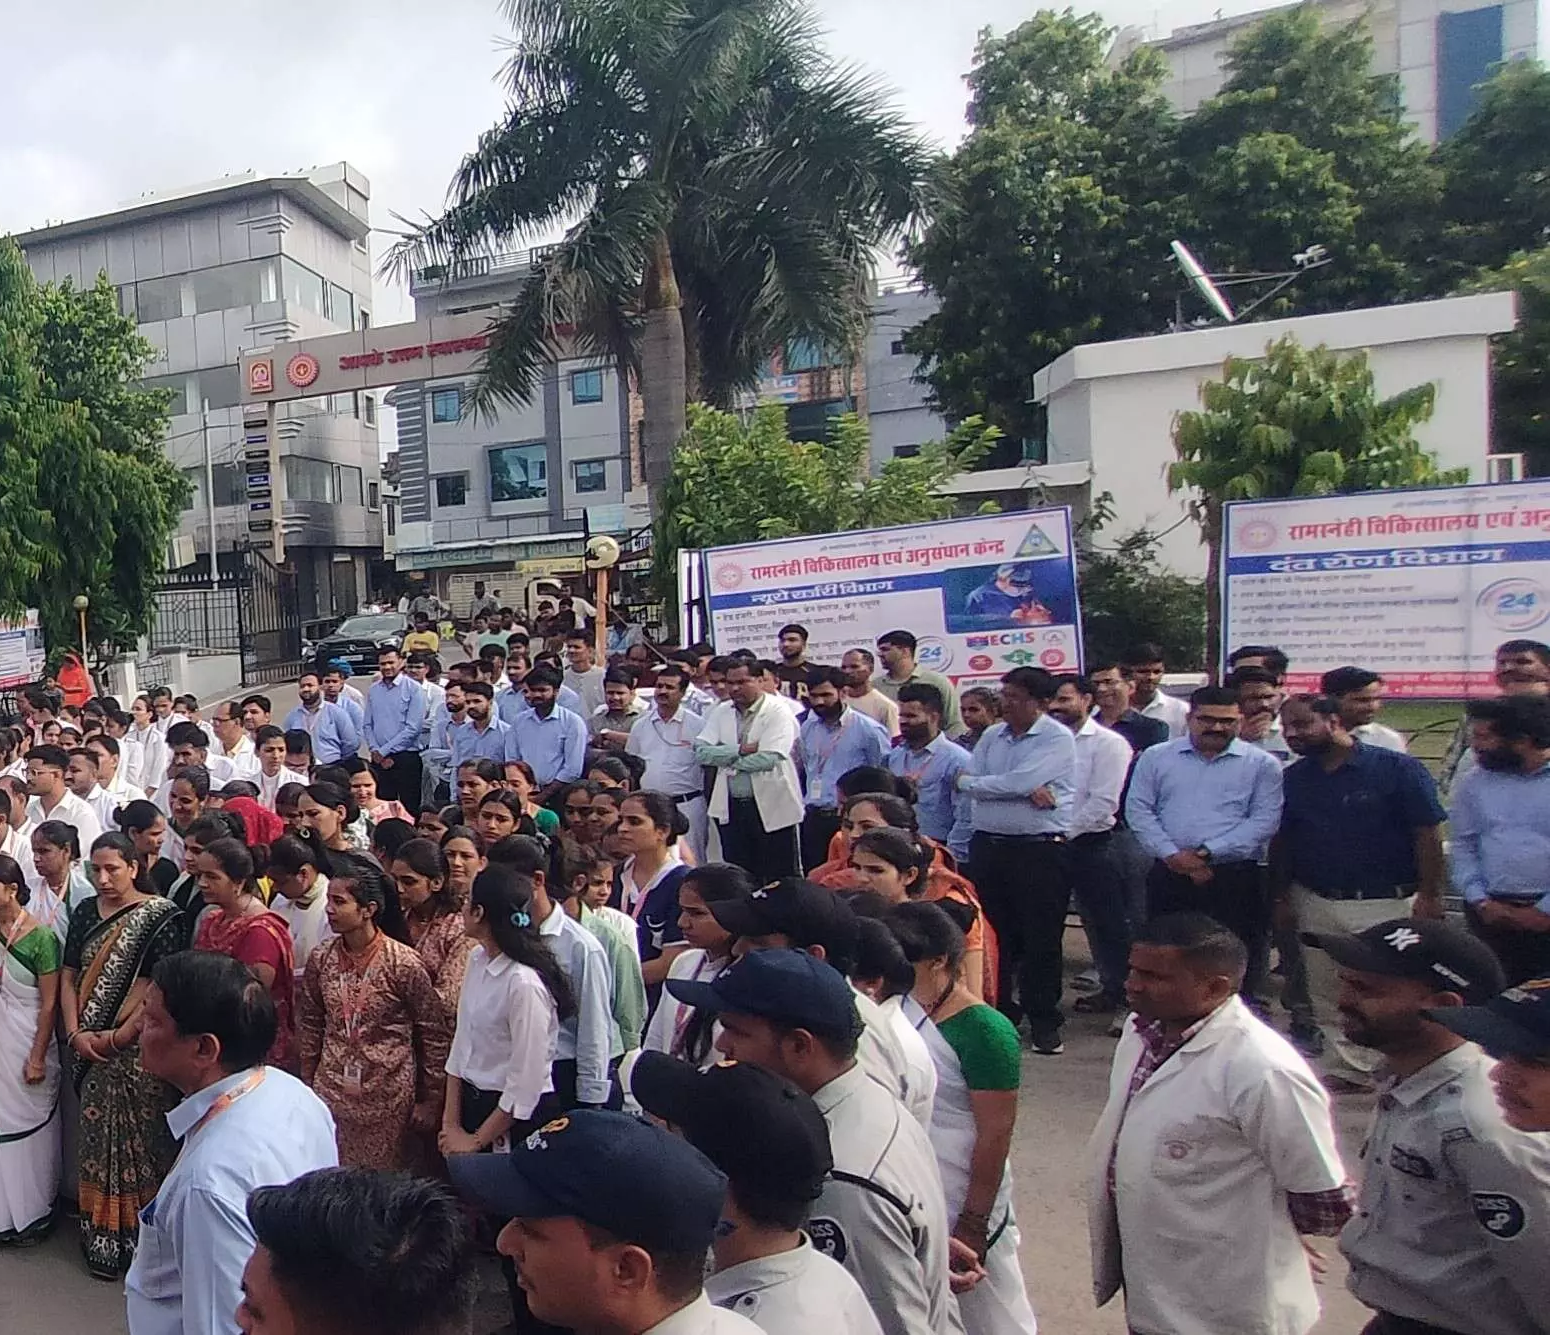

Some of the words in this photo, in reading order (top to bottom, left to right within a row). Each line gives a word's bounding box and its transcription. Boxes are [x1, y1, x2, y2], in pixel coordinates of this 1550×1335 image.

[1367, 514, 1480, 537] चिकित्सालय
[1486, 506, 1517, 529] एवं
[1268, 556, 1317, 573] दंत
[1322, 553, 1387, 570] रोग
[1390, 548, 1506, 567] विभाग
[1497, 593, 1537, 609] 24
[990, 632, 1035, 646] ECHS
[919, 646, 942, 658] 24
